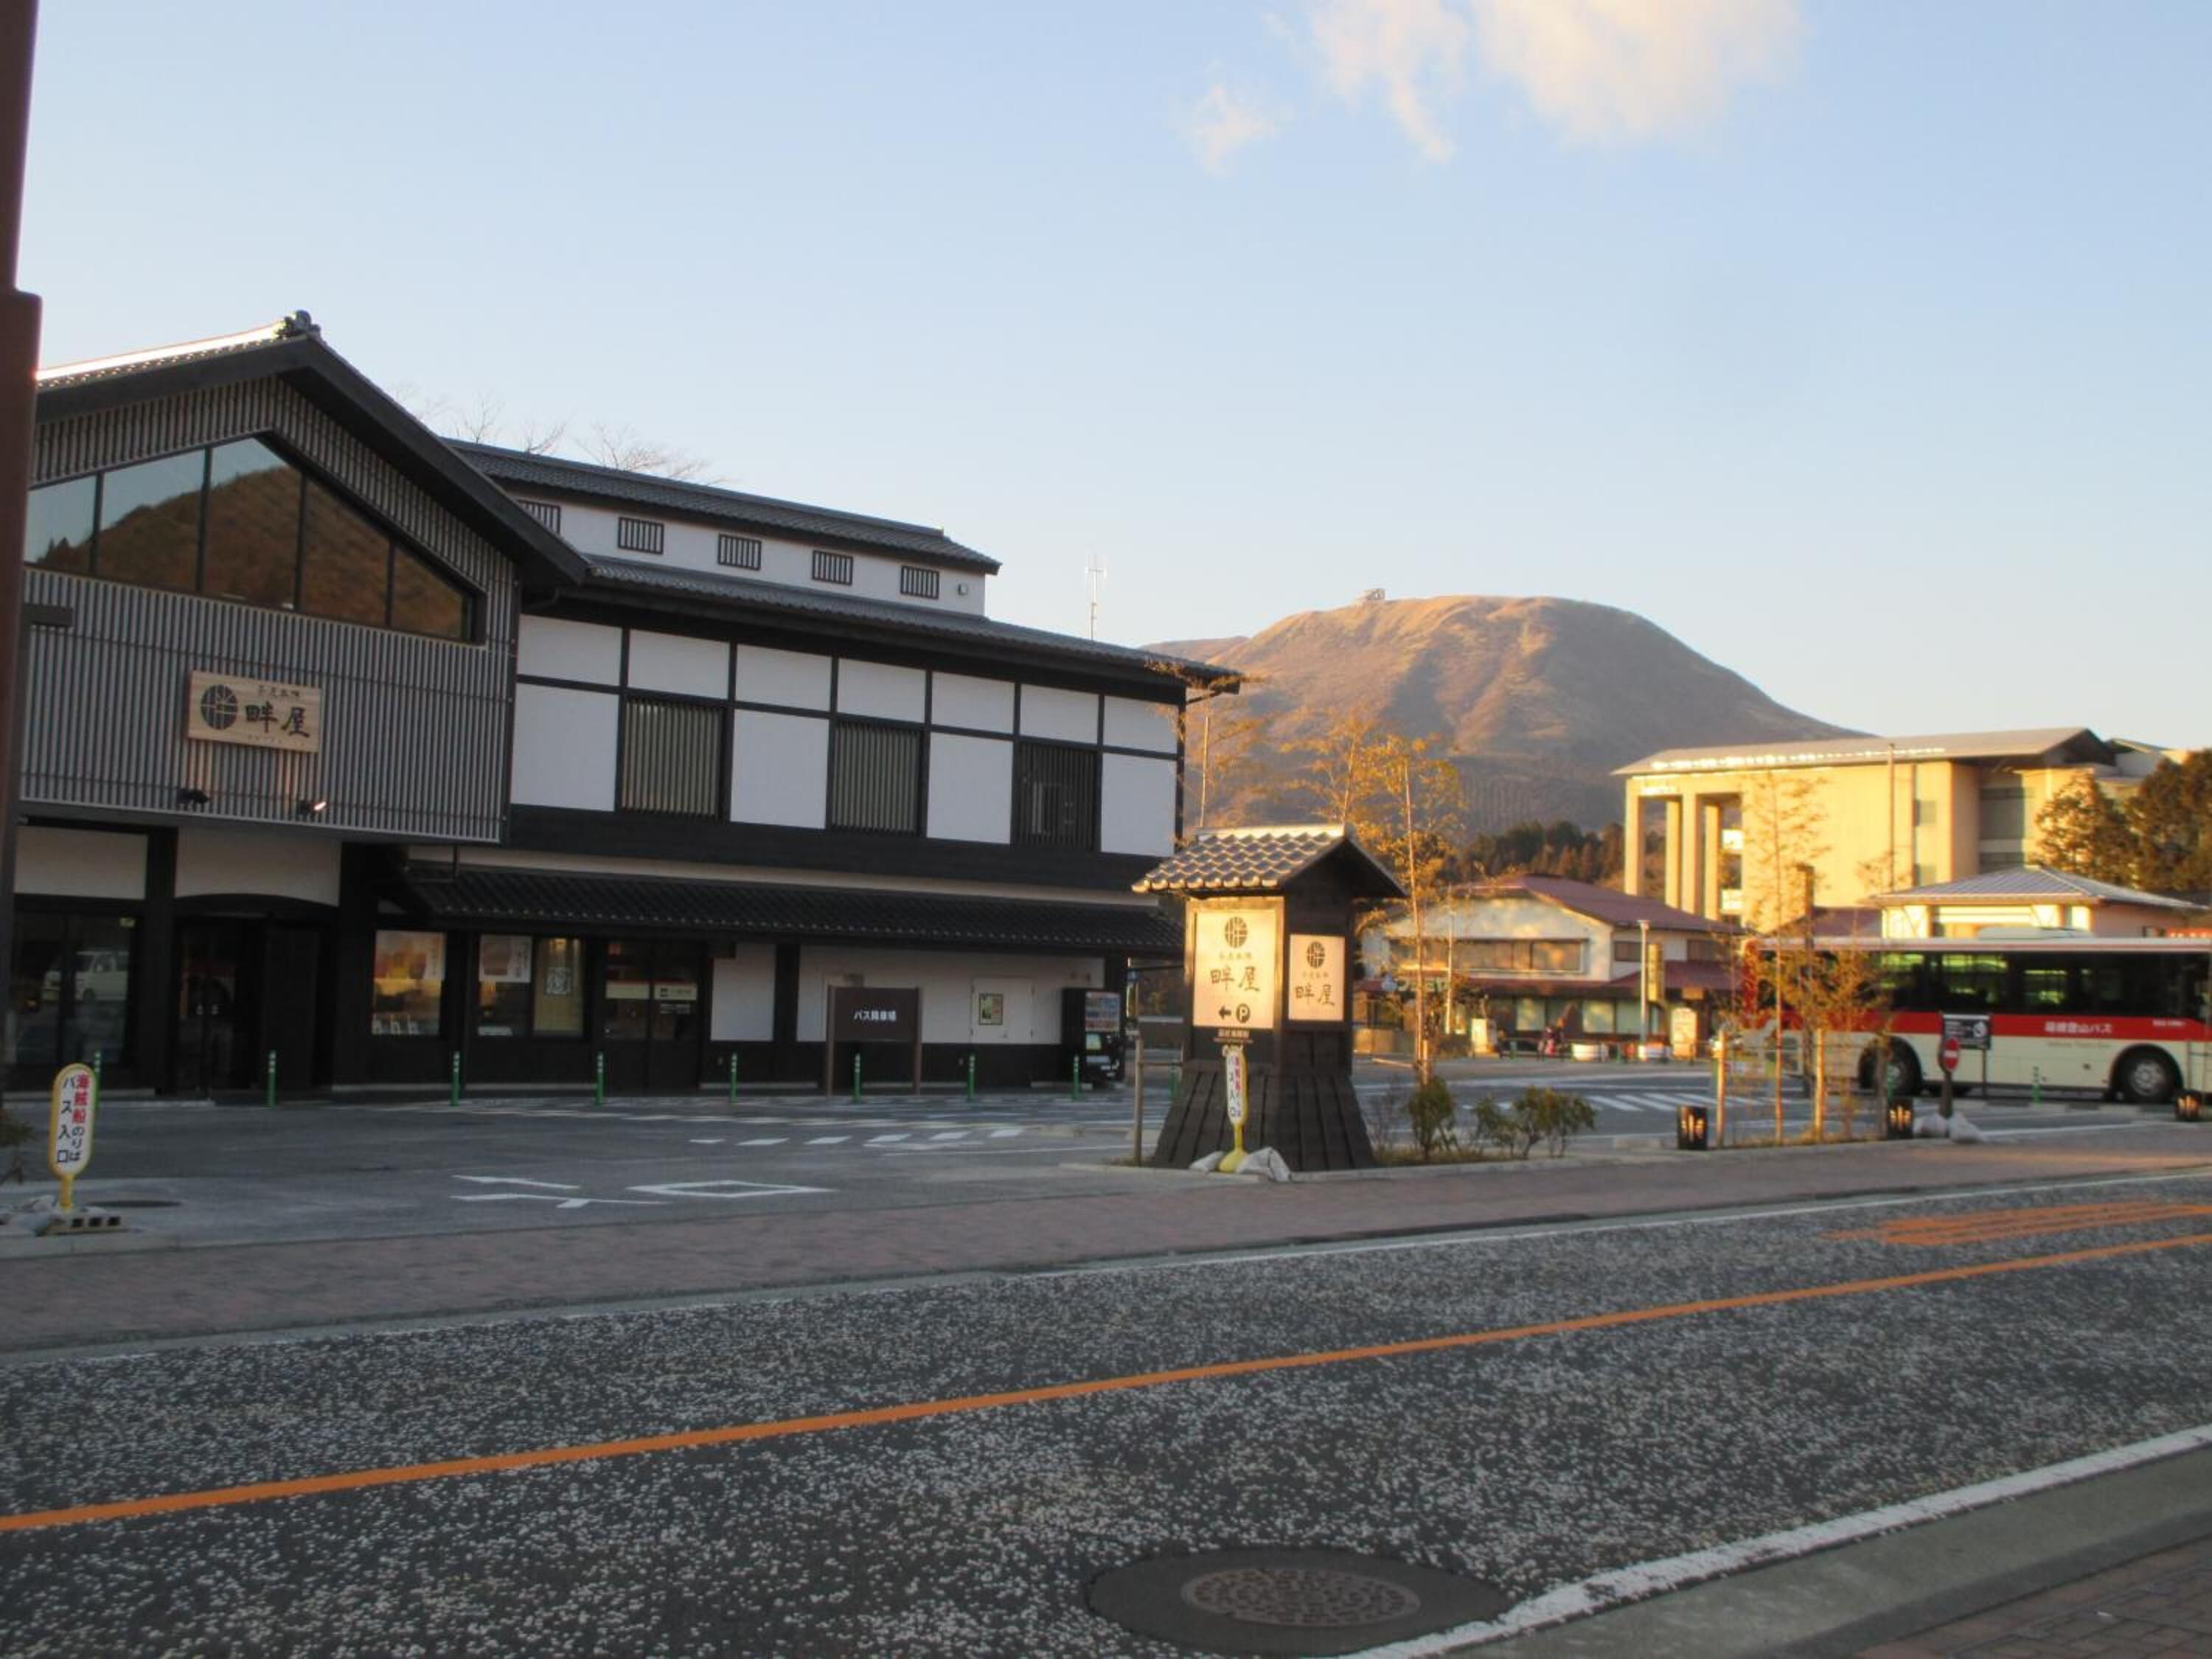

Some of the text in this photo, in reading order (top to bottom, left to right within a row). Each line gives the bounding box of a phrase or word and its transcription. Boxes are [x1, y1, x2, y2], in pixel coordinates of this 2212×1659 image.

[245, 700, 310, 737] 畔屋
[1210, 965, 1260, 992] 畔屋
[1295, 982, 1335, 1006] 畔屋
[58, 1077, 75, 1163] バス入口
[69, 1074, 89, 1161] 海賊船のりば
